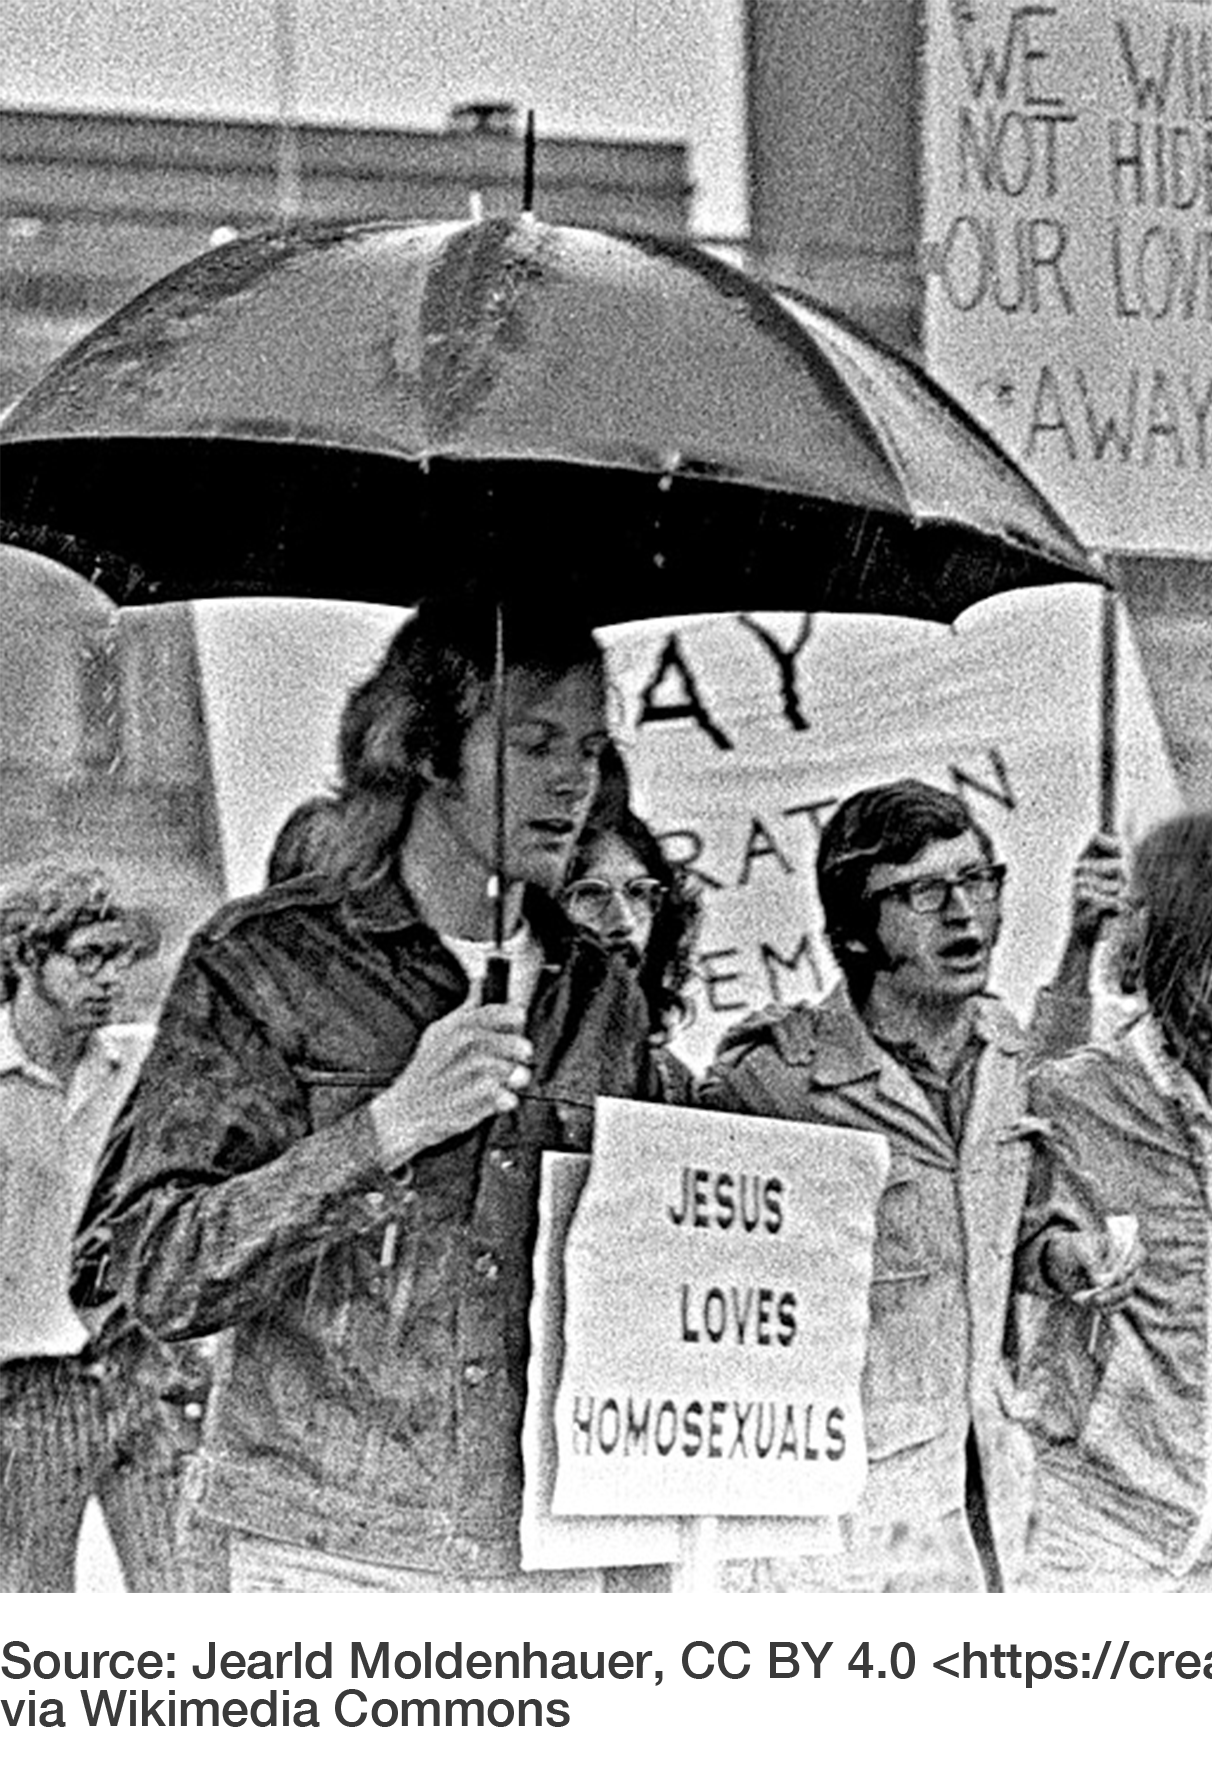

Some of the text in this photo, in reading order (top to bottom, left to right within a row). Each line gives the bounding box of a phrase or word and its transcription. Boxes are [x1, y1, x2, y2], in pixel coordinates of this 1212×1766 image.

[953, 3, 1064, 106] WE
[957, 108, 1077, 198] NOT
[942, 214, 1074, 314] OUR
[634, 610, 812, 750] AY
[667, 1166, 786, 1234] JESUS
[680, 1284, 799, 1347] LOVES
[571, 1395, 848, 1463] HOMOSEXUALS
